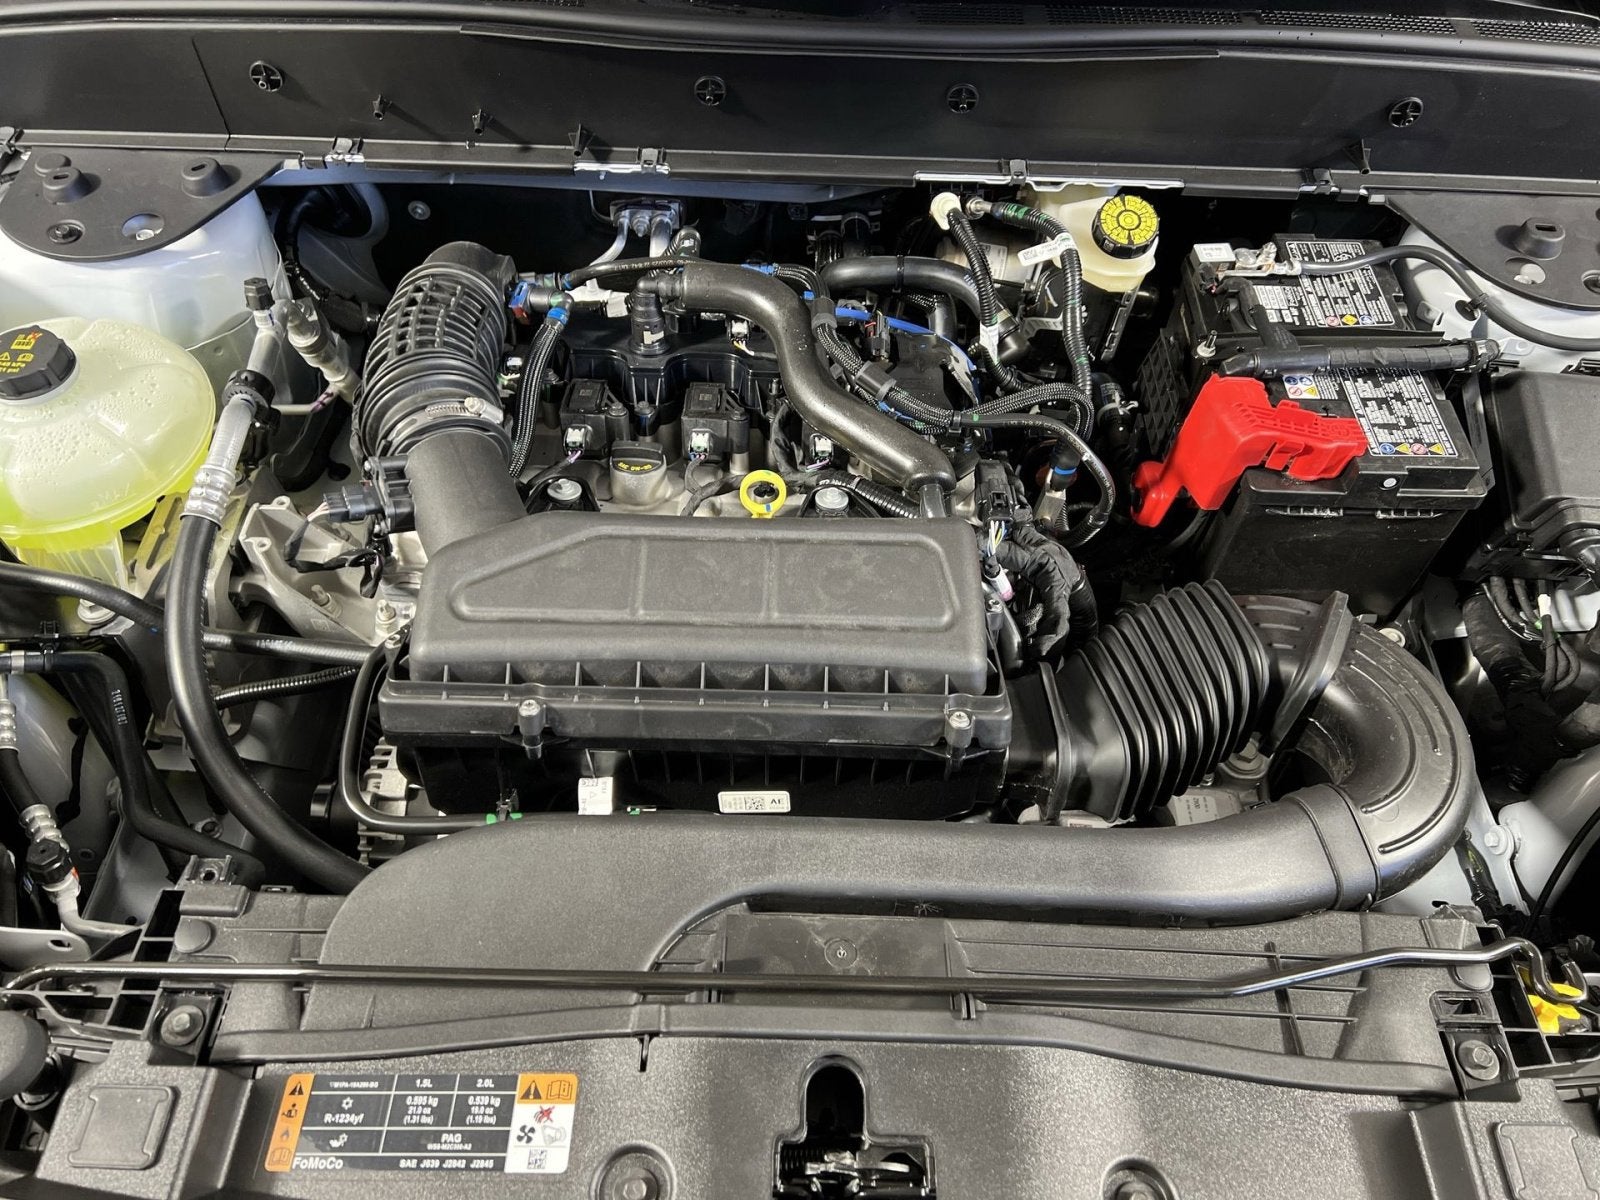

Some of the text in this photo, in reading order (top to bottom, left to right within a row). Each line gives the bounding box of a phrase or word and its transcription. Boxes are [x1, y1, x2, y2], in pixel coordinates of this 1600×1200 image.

[618, 462, 629, 470] SAE
[416, 1079, 433, 1088] 1.5L
[476, 1079, 494, 1088] 2.0L
[428, 1096, 438, 1107] kg
[468, 1096, 501, 1107] 0.539 kg
[471, 1106, 485, 1114] 19.0
[324, 1113, 364, 1125] R-1234yf
[403, 1115, 434, 1125] (1.31 lbs)
[466, 1115, 497, 1125] (1.19 lbs)
[441, 1133, 462, 1143] PAG
[292, 1157, 343, 1169] FoMoCo
[399, 1159, 417, 1168] SAE
[420, 1159, 440, 1168] J639
[469, 1159, 494, 1168] J2845
